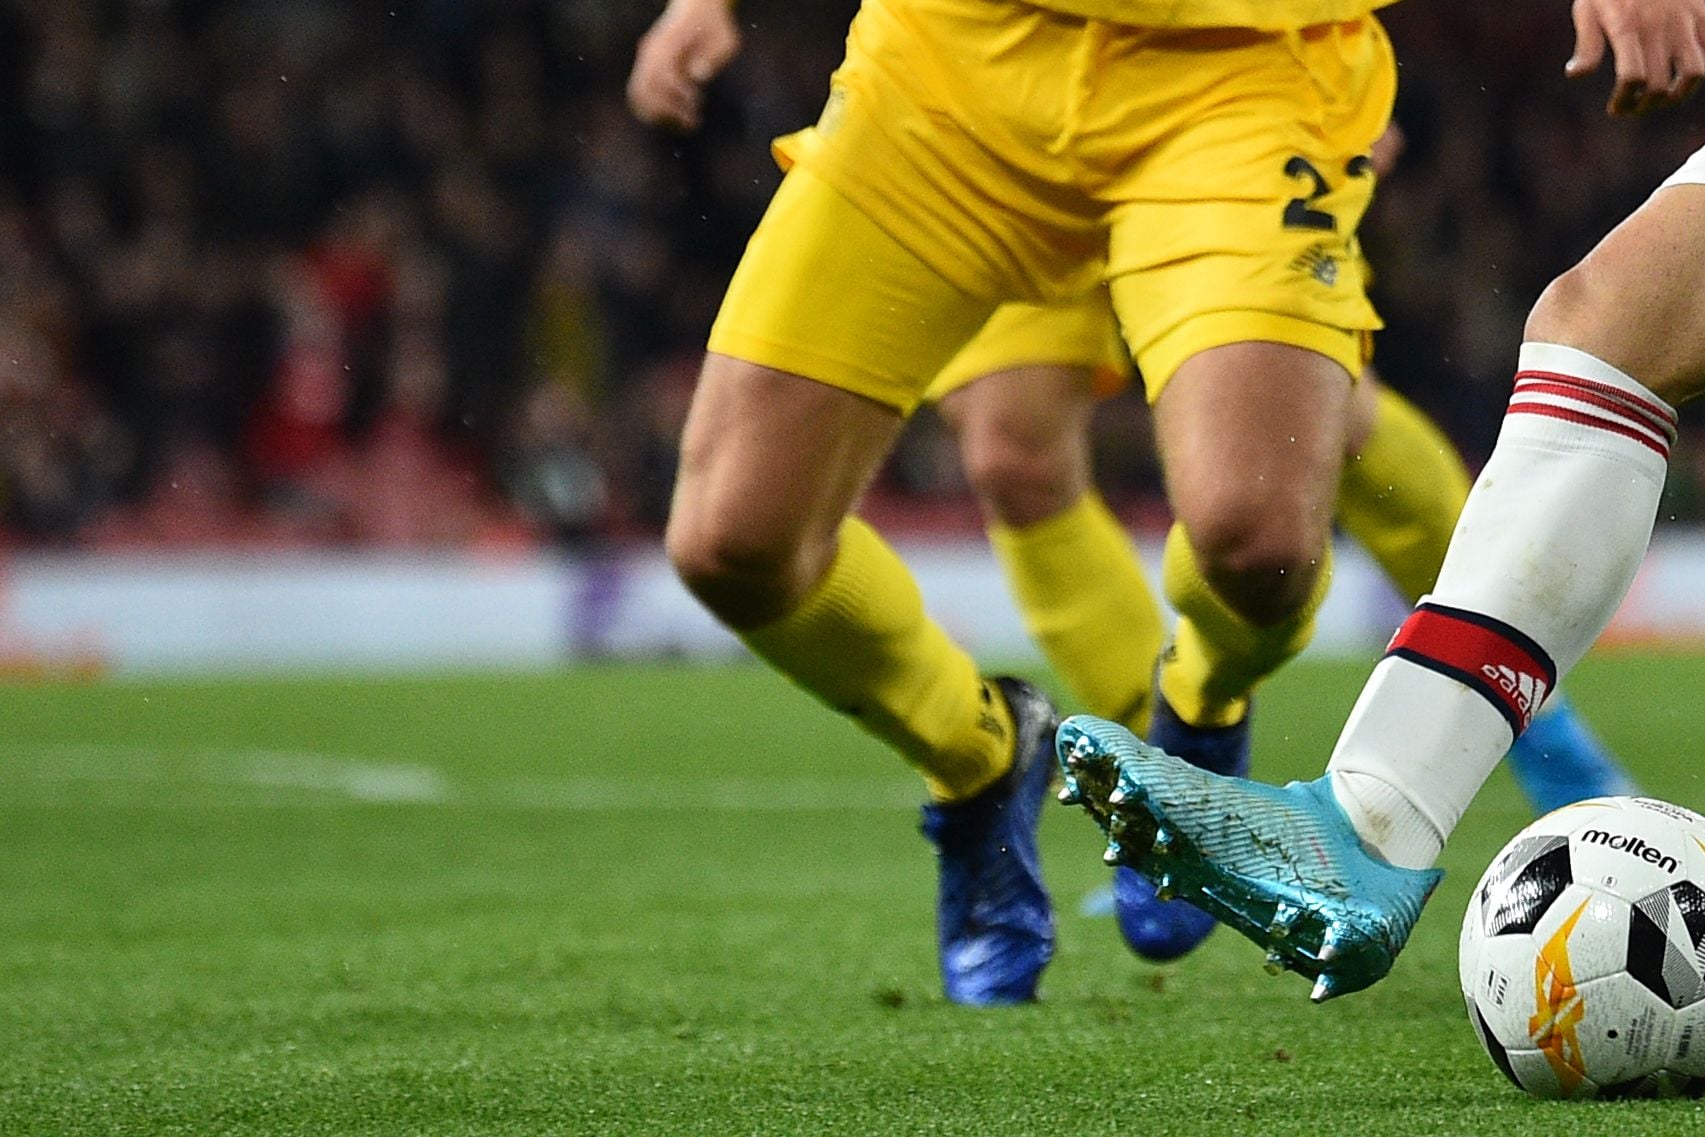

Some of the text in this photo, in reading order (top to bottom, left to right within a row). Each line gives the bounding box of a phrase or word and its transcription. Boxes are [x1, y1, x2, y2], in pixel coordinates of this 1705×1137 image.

[1580, 828, 1679, 875] molten
[1605, 876, 1614, 885] 5
[1495, 976, 1508, 1006] FIFA
